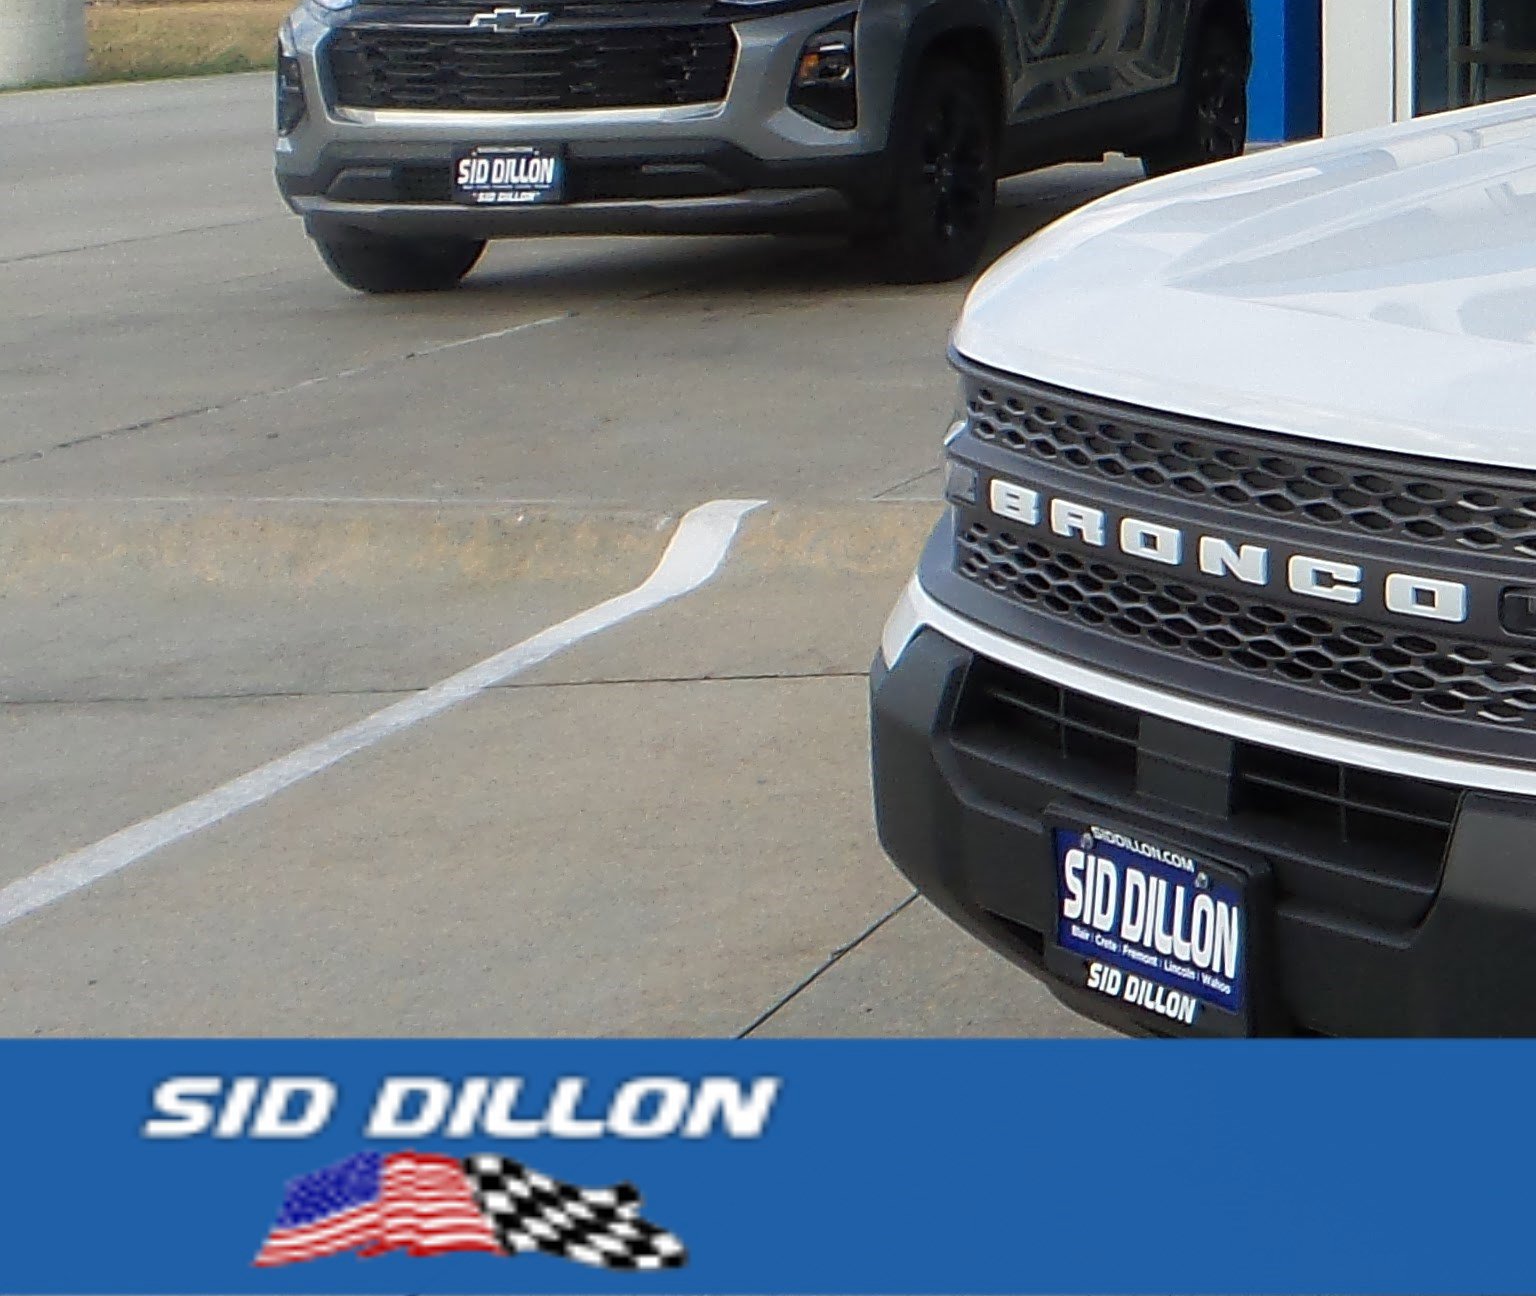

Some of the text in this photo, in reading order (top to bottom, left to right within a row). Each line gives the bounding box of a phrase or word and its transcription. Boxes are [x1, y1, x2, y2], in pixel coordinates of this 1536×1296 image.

[457, 158, 555, 184] SID DILLON
[989, 478, 1468, 621] BRONCO
[1090, 826, 1195, 872] SIDDILLON.COM
[1063, 849, 1238, 979] SID DILLON
[1087, 961, 1197, 1025] SID DILLON
[1163, 960, 1195, 981] Lincoln
